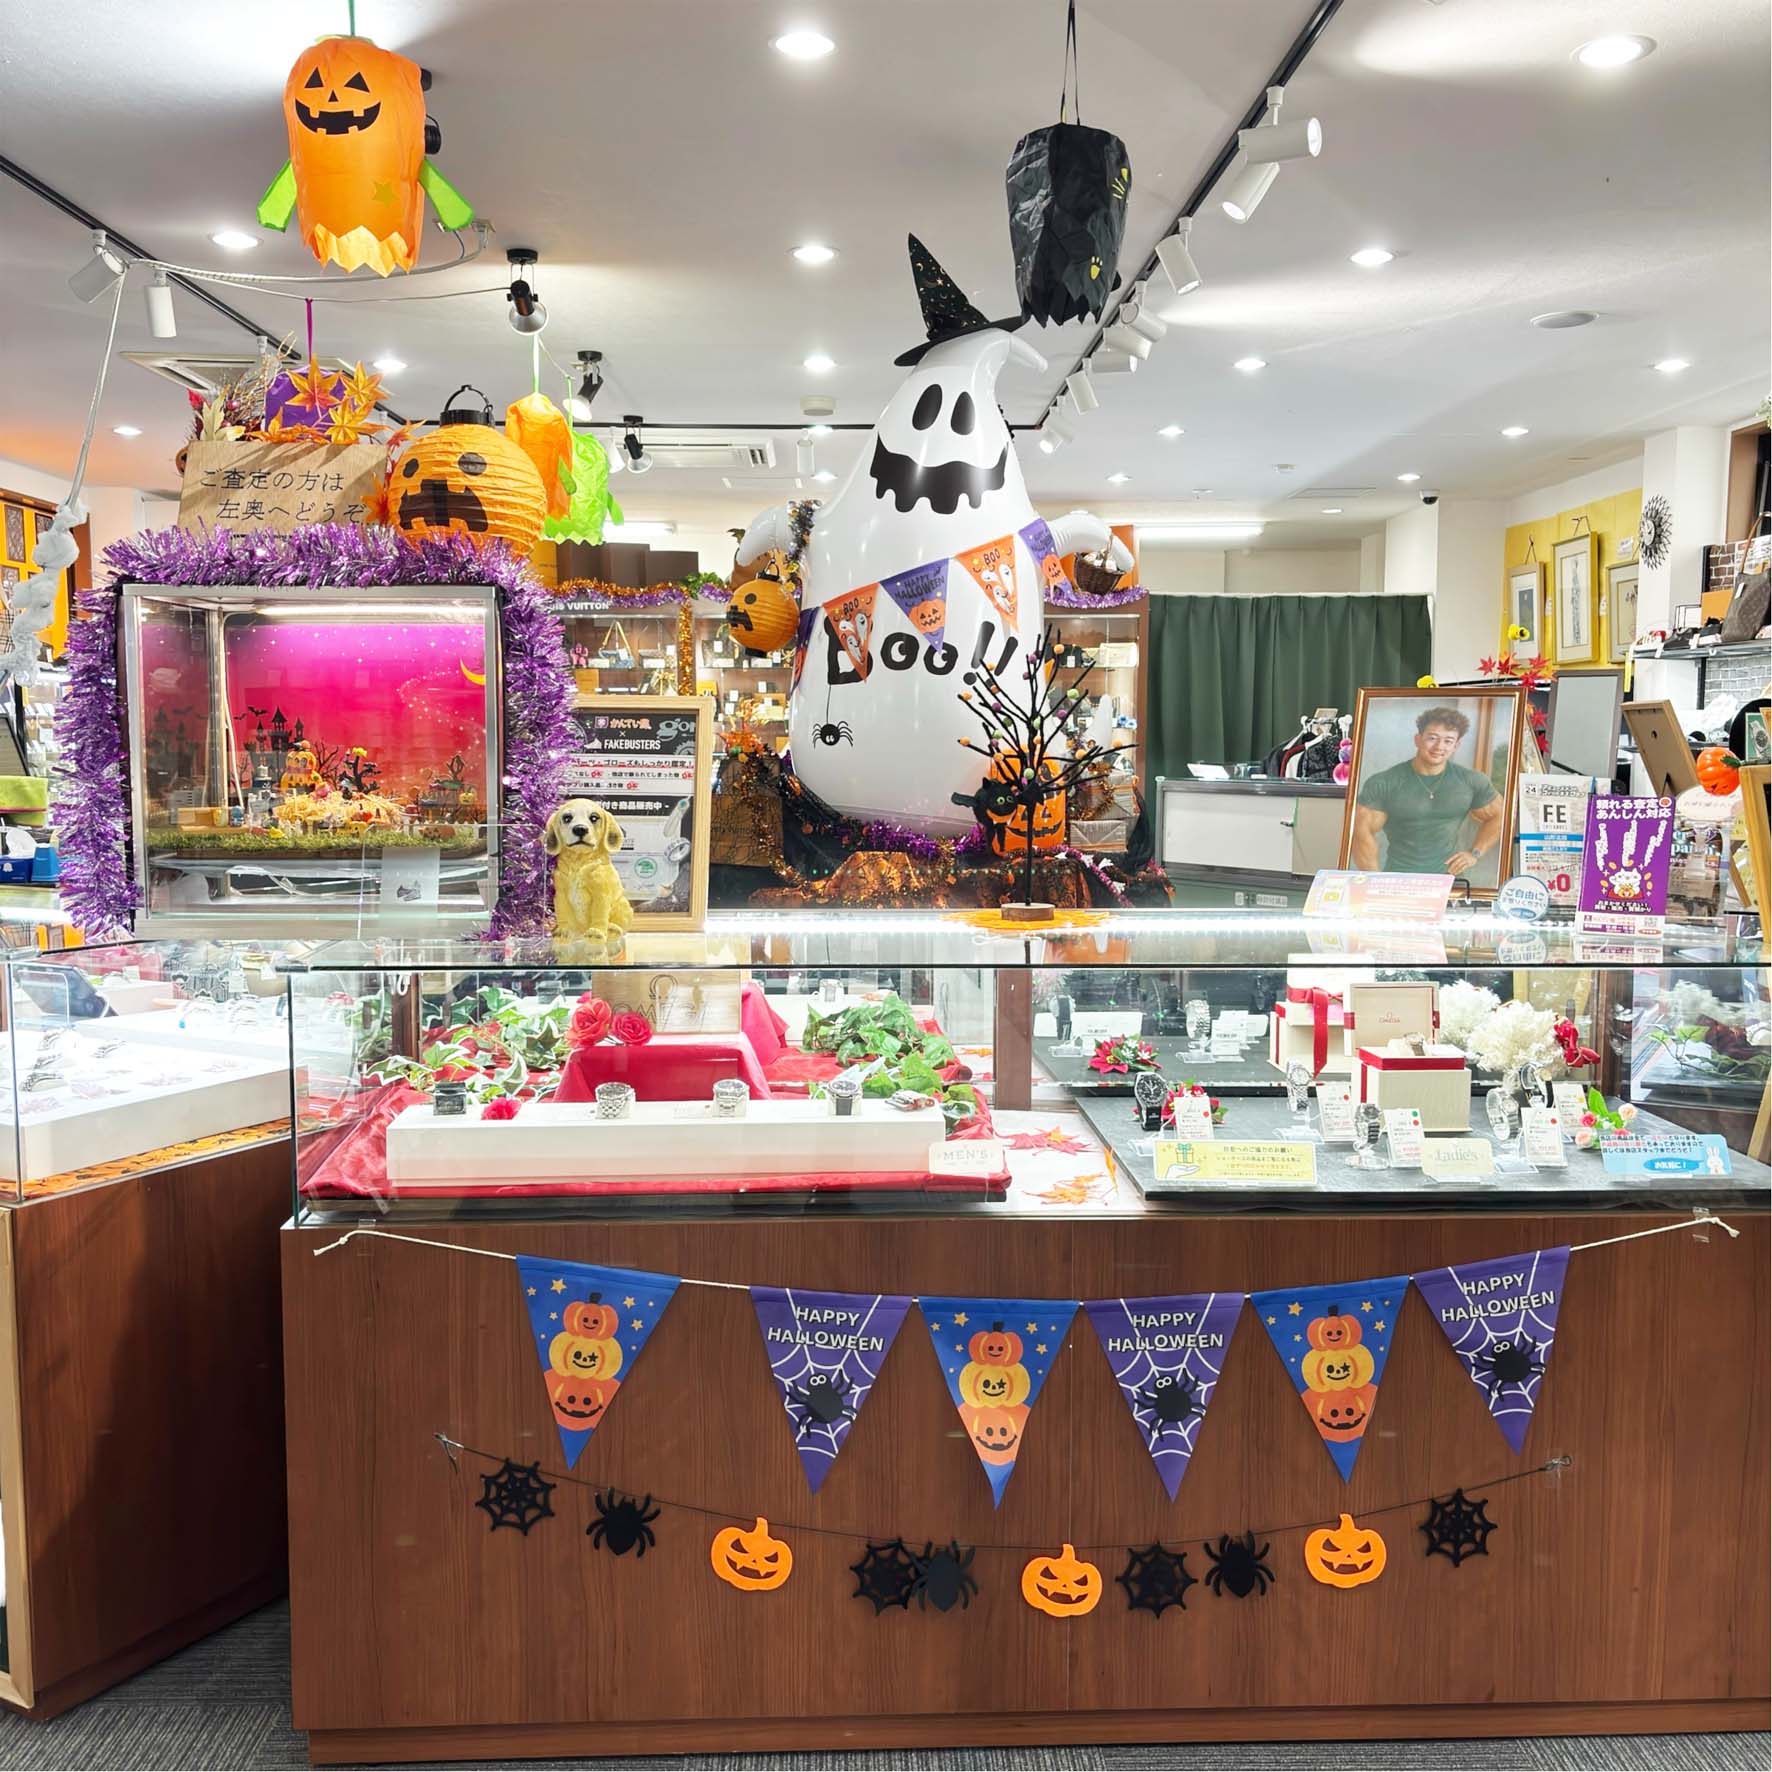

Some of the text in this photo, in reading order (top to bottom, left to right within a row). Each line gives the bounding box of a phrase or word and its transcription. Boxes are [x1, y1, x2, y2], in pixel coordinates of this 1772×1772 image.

[199, 468, 345, 492] ご査定の方は
[983, 547, 1001, 566] BOO
[894, 575, 945, 600] HALLOWEEN
[903, 573, 930, 588] HAPPY
[567, 601, 609, 611] VUITTON
[843, 597, 860, 615] BOO
[603, 738, 662, 751] FAKEBUSTERS
[1525, 786, 1537, 795] 24
[1595, 808, 1672, 820] あんしん対応
[1547, 872, 1572, 893] ¥0
[1504, 887, 1546, 902] ご自由に
[943, 1149, 990, 1161] MEN'S
[1461, 1273, 1527, 1297] HAPPY
[1440, 1289, 1556, 1323] HALLOWEEN
[795, 1306, 861, 1328] HAPPY
[1131, 1311, 1199, 1329] HAPPY
[766, 1326, 885, 1353] HALLOWEEN
[1107, 1333, 1225, 1353] HALLOWEEN
